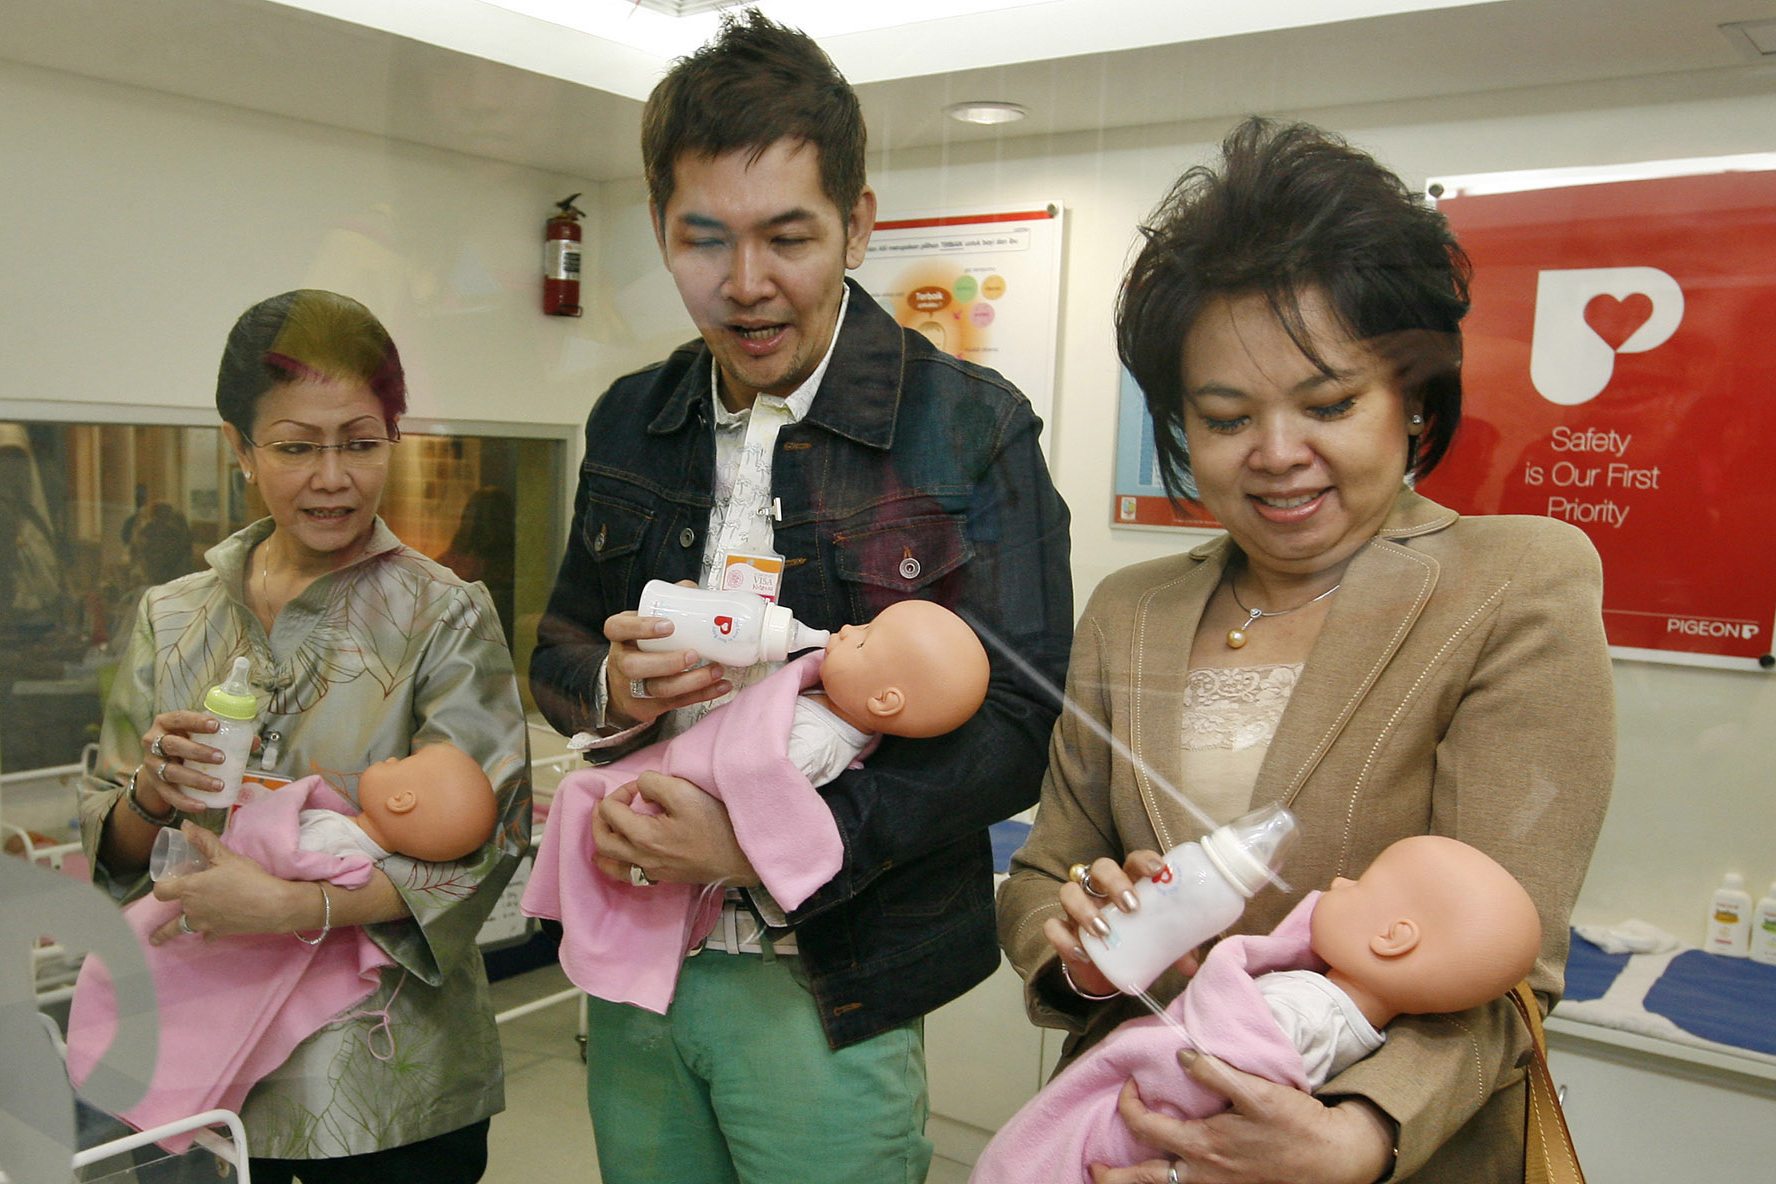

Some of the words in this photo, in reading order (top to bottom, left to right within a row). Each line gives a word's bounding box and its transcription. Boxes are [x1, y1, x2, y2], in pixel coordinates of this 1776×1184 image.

[1550, 426, 1632, 457] Safety
[1524, 462, 1544, 485] is
[1551, 461, 1601, 488] Our
[1606, 462, 1661, 490] First
[1547, 496, 1630, 528] Priority
[1667, 618, 1741, 639] PIGEON
